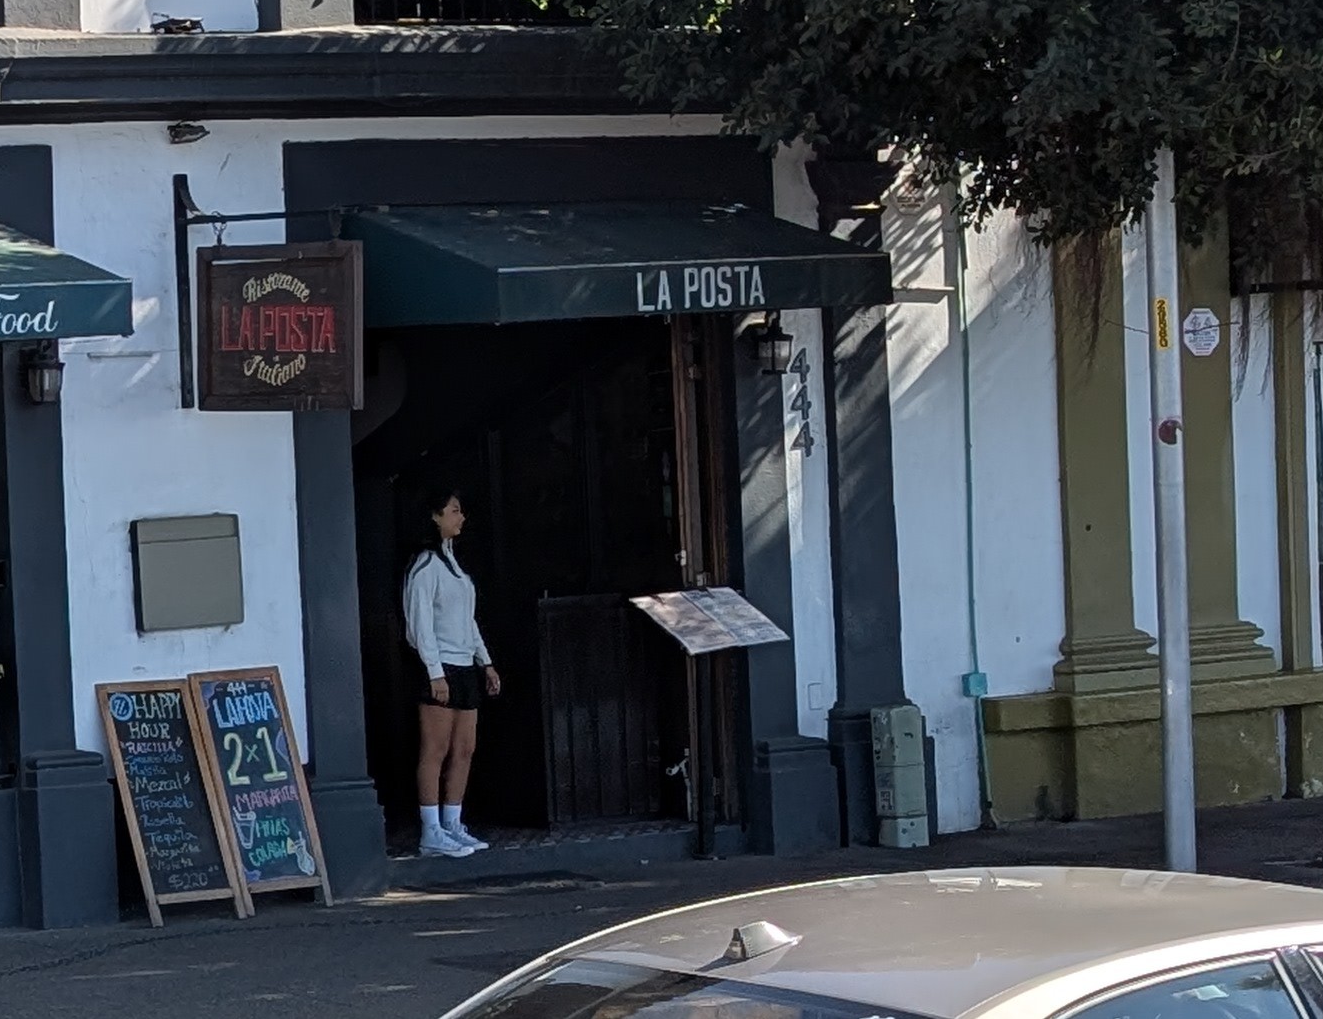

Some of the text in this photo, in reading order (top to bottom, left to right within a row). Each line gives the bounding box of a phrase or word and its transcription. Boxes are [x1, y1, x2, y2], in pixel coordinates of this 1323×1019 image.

[243, 271, 311, 304] Ristorante
[636, 265, 766, 312] LA POSTA
[221, 304, 337, 354] LA POSTA
[131, 692, 182, 719] HAPPY
[128, 722, 171, 739] HOUR
